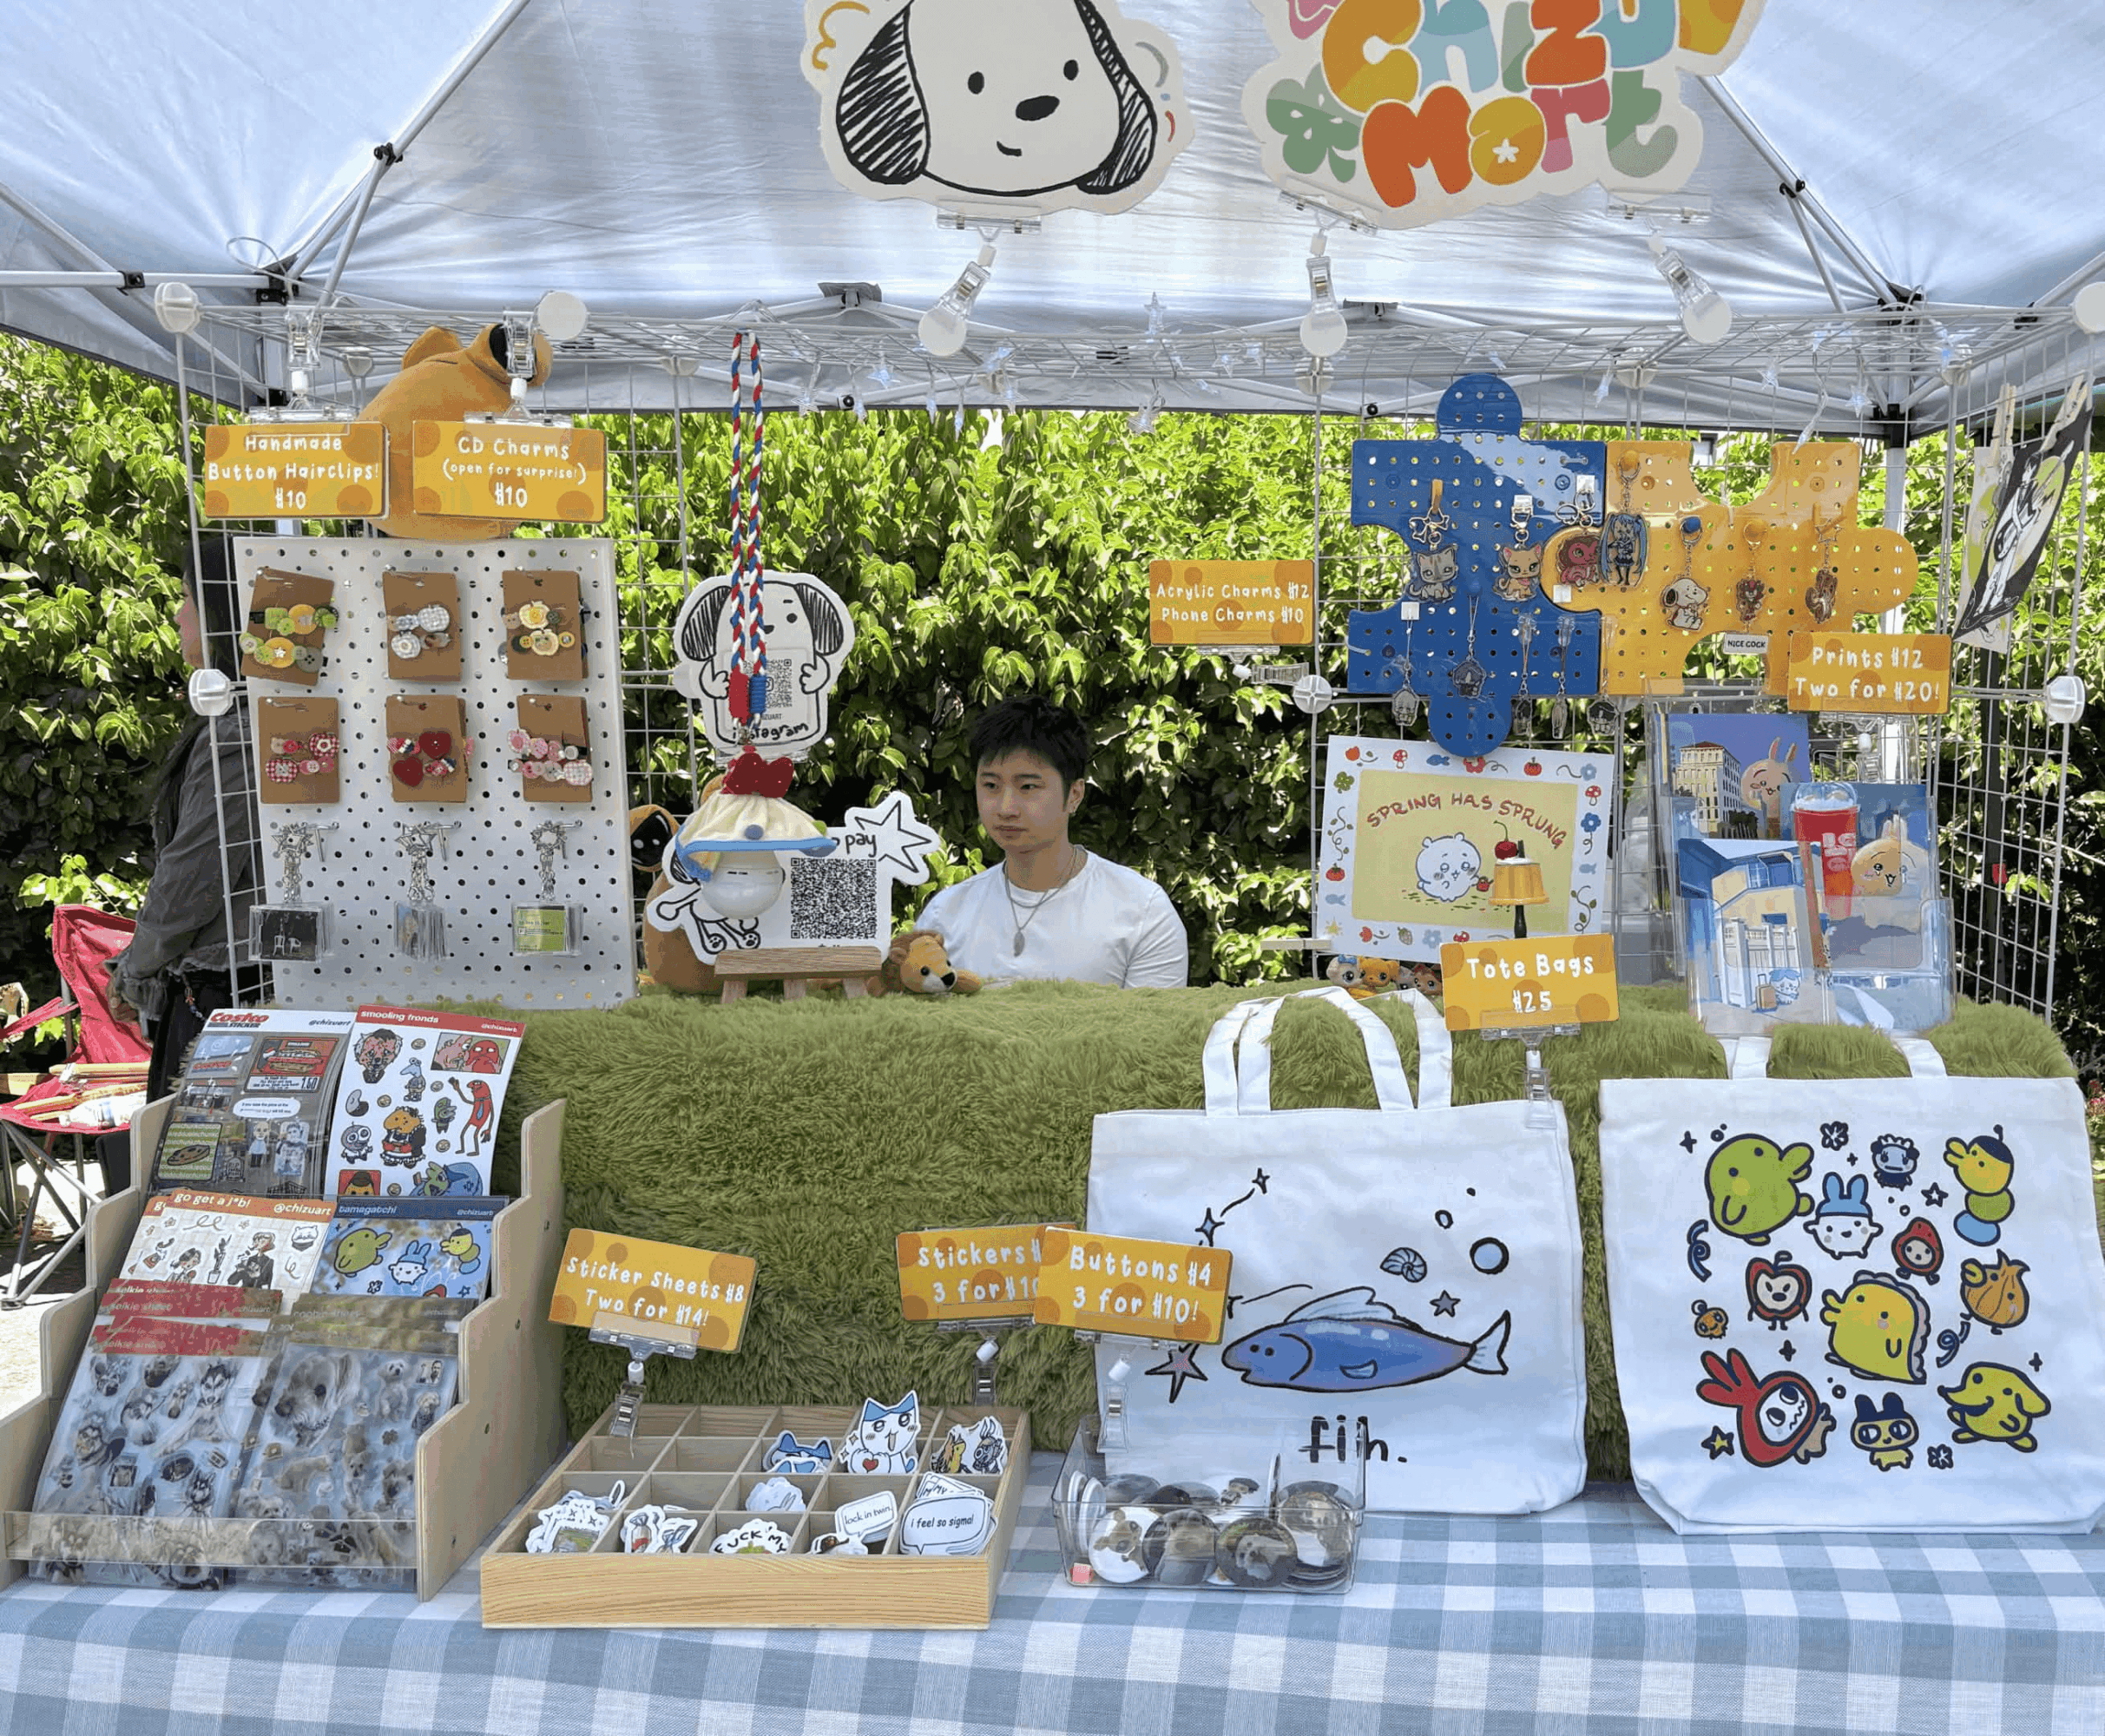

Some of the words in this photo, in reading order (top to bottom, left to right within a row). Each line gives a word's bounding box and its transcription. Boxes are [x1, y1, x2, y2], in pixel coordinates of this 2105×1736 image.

[245, 434, 343, 451] Handmade
[457, 436, 484, 454] CD
[493, 437, 569, 460] Charms
[207, 462, 277, 481] Button
[285, 462, 379, 483] Hairclips!
[442, 457, 483, 482] (open
[488, 462, 511, 475] for
[516, 462, 587, 486] surprise!)
[274, 487, 306, 510] $10
[494, 482, 528, 509] $10
[1156, 582, 1214, 602] Acrylic
[1221, 584, 1281, 600] Charms
[1287, 582, 1310, 601] $12
[1161, 607, 1208, 623] Phone
[1215, 607, 1275, 623] Charms
[1281, 606, 1304, 624] $10
[1812, 646, 1883, 669] Prints
[1891, 647, 1924, 669] $12
[1795, 677, 1839, 697] Two
[1850, 678, 1887, 699] for
[1893, 681, 1939, 702] $20!
[1367, 792, 1442, 828] SPRING
[1451, 792, 1493, 811] HAS
[1497, 799, 1568, 850] SPRUNG
[845, 832, 878, 858] pay
[1466, 957, 1526, 980] Tote
[1536, 952, 1594, 977] Bags
[1512, 990, 1553, 1013] $25
[174, 1193, 191, 1204] go
[193, 1193, 215, 1205] get
[273, 1204, 332, 1215] @chizuart
[918, 1241, 1026, 1269] Stickers
[1069, 1245, 1179, 1284] Buttons
[1187, 1260, 1211, 1286] $4
[566, 1257, 642, 1285] Sticker
[650, 1271, 721, 1300] Sheets
[725, 1283, 745, 1304] $8
[932, 1281, 945, 1304] 3
[957, 1279, 1000, 1304] for
[585, 1287, 624, 1312] Two
[634, 1297, 668, 1318] for
[675, 1304, 710, 1326] $14!
[1072, 1286, 1086, 1309] 3
[1099, 1287, 1142, 1314] for
[1152, 1292, 1199, 1324] $10!
[1298, 1414, 1407, 1463] fih.
[844, 1513, 864, 1525] lock
[917, 1517, 935, 1529] feel
[937, 1519, 946, 1528] so
[714, 1529, 763, 1554] FUCK
